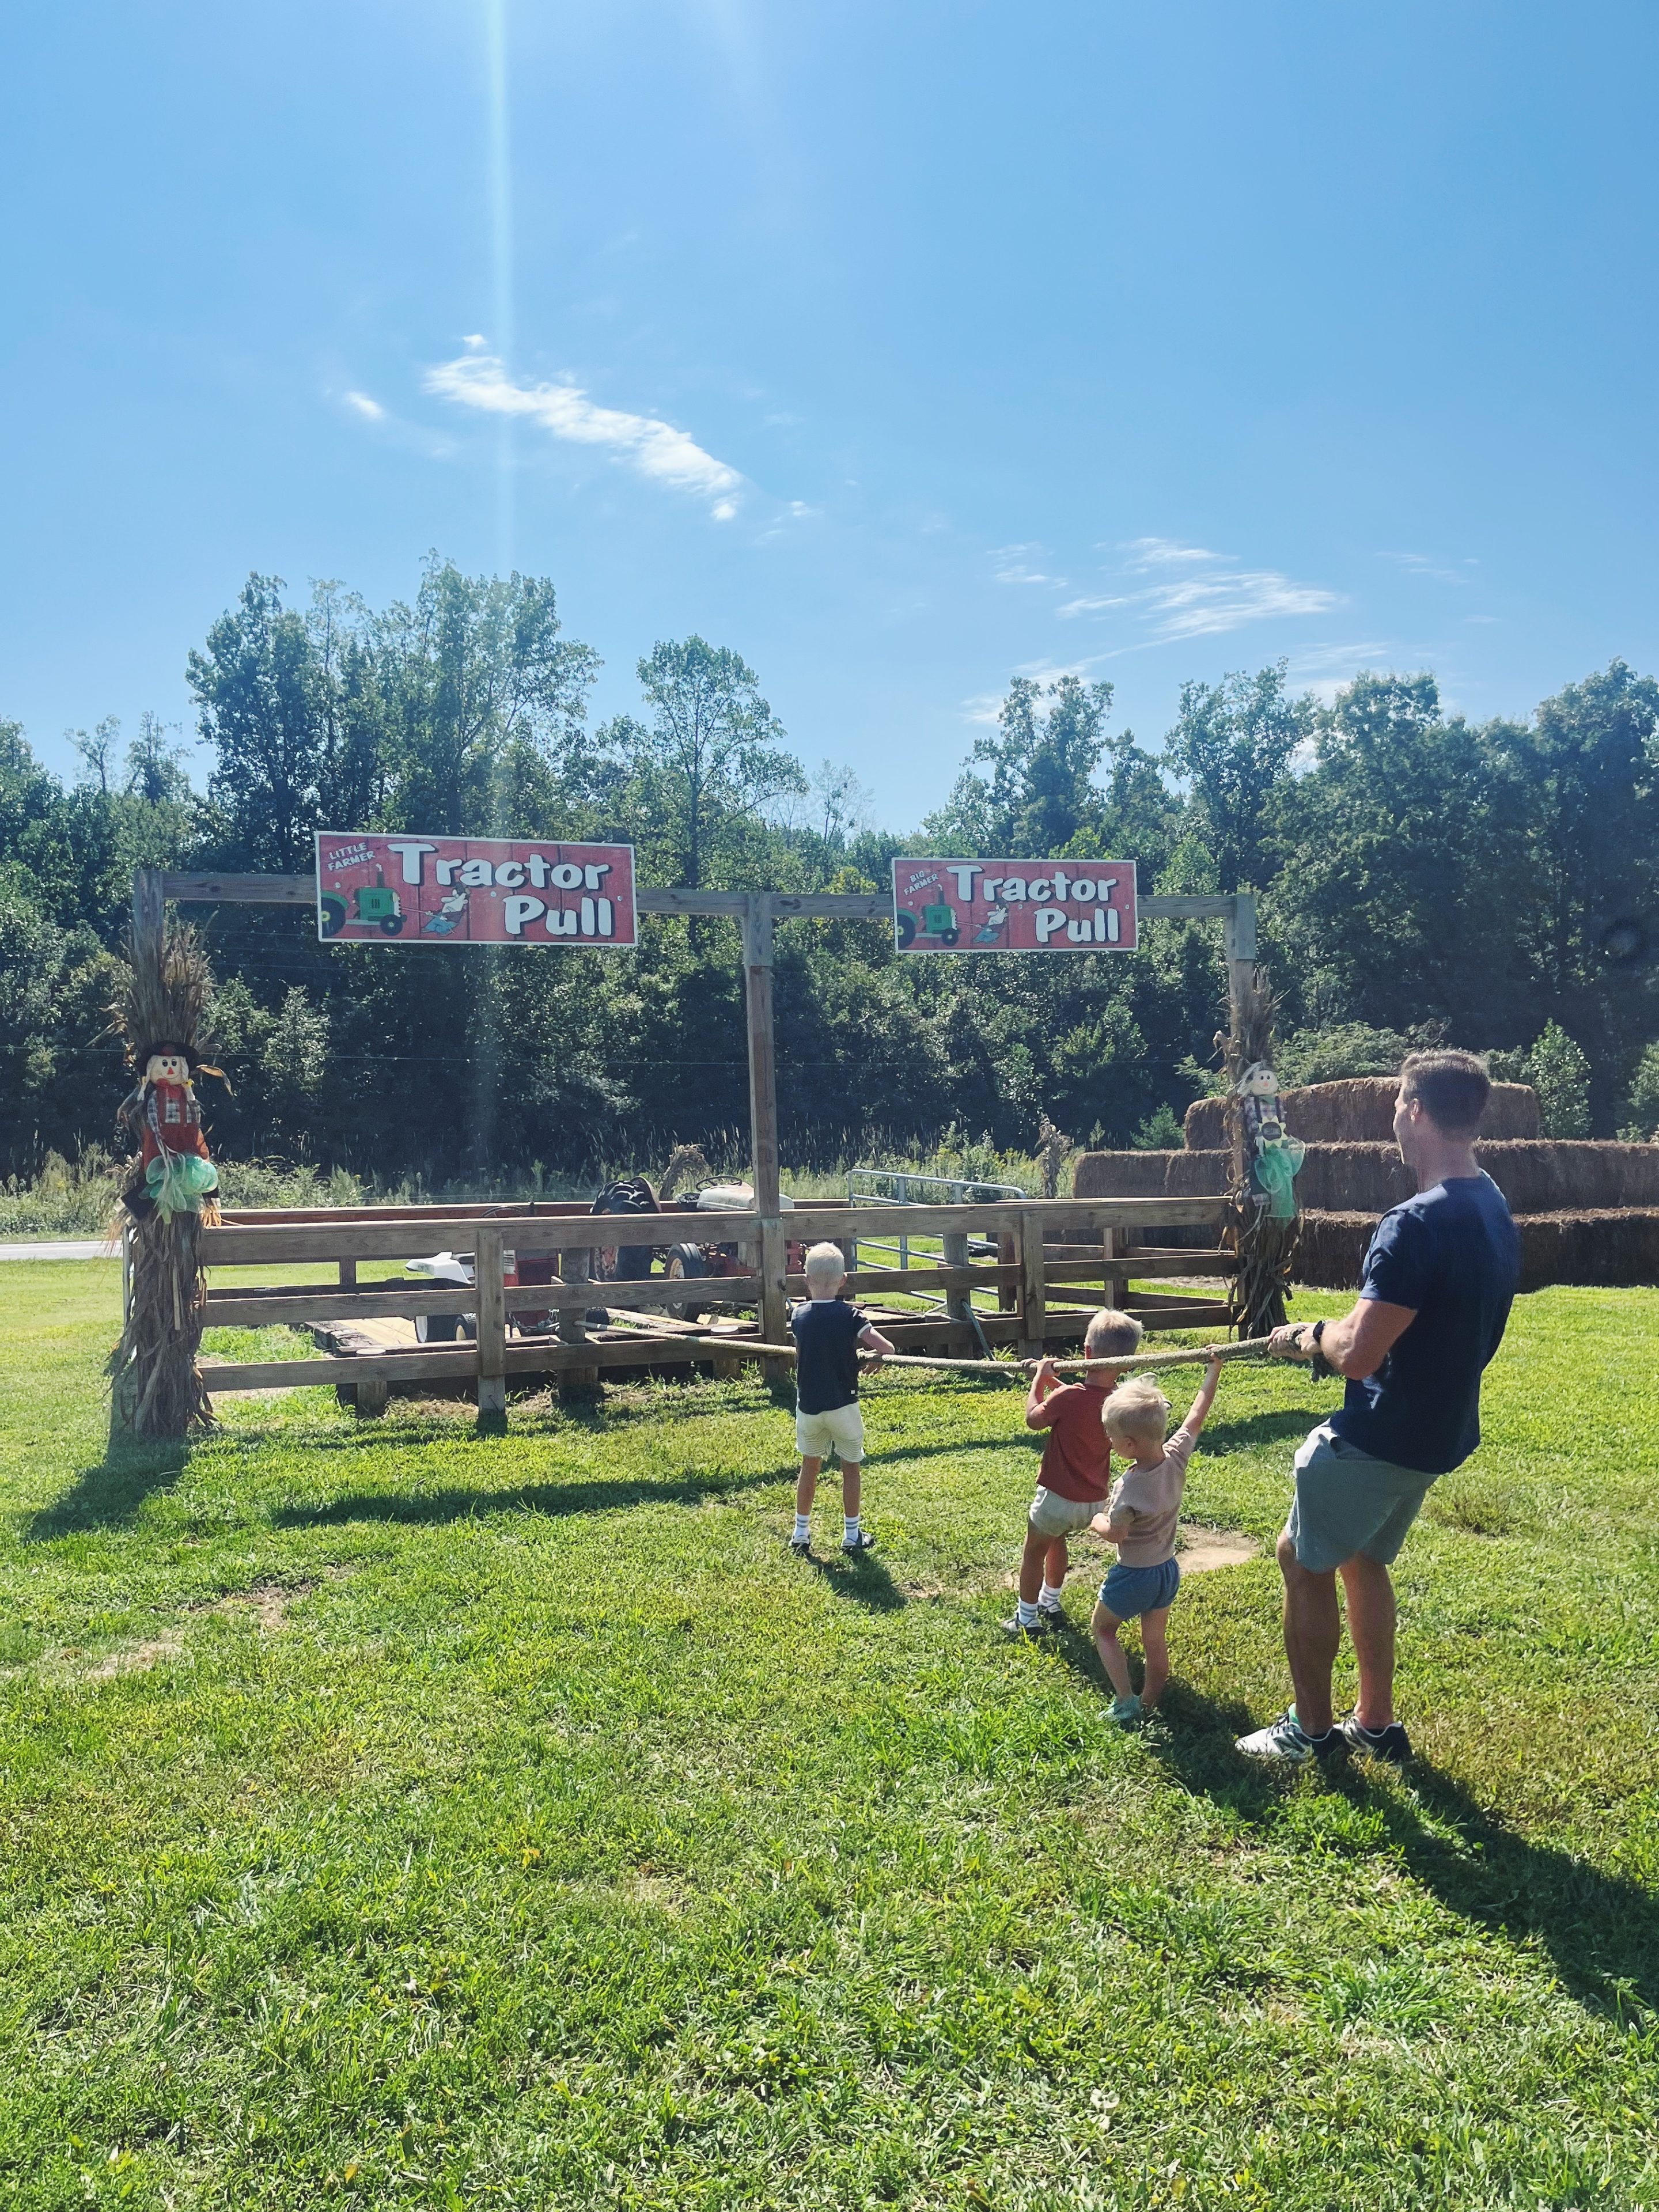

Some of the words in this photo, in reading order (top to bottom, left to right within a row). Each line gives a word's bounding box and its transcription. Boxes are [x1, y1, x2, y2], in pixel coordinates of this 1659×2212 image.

[328, 851, 376, 871] FARMER
[329, 842, 367, 860] LITTLE
[387, 843, 609, 890] Tractor
[910, 870, 925, 882] BIG
[904, 873, 938, 895] FARMER
[946, 865, 1117, 902] Tractor
[503, 895, 612, 936] Pull
[1034, 908, 1119, 942] Pull
